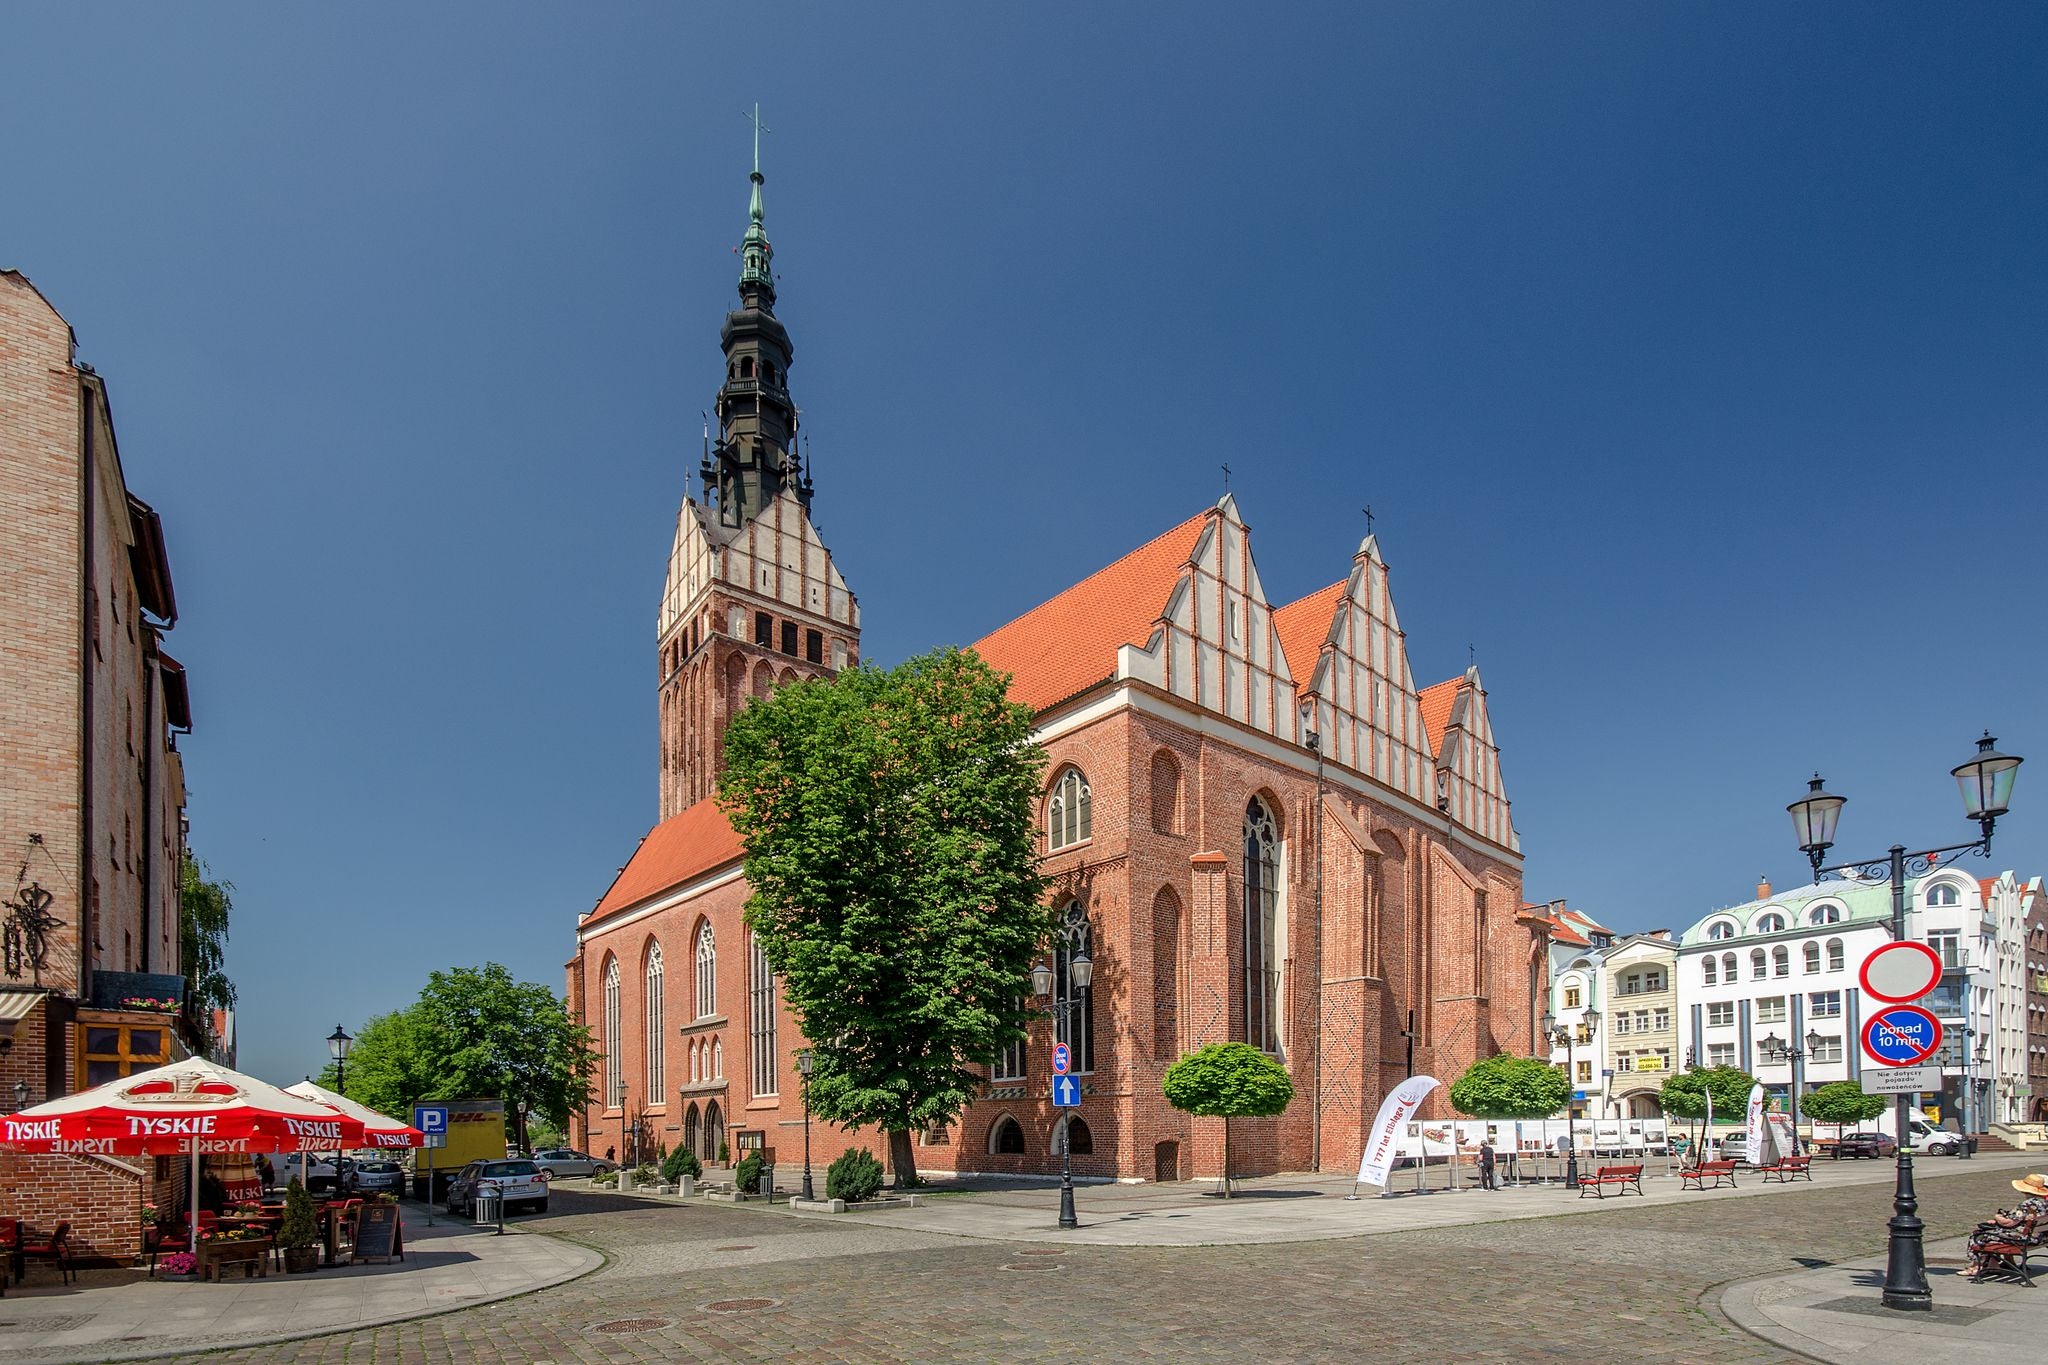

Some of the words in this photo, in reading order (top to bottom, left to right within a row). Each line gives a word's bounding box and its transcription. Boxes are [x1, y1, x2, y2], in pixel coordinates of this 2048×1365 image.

[1880, 1023, 1922, 1037] ponad
[1878, 1036, 1893, 1047] 10
[1895, 1036, 1924, 1046] min.
[1885, 1076, 1915, 1084] pojazdu
[5, 1118, 62, 1141] TYSKIE
[126, 1115, 218, 1136] TYSKIE
[282, 1117, 343, 1138] TYSKIE
[423, 1111, 441, 1131] P
[373, 1133, 412, 1146] TYSKIE
[1374, 1147, 1386, 1162] 777
[1380, 1135, 1391, 1147] lat
